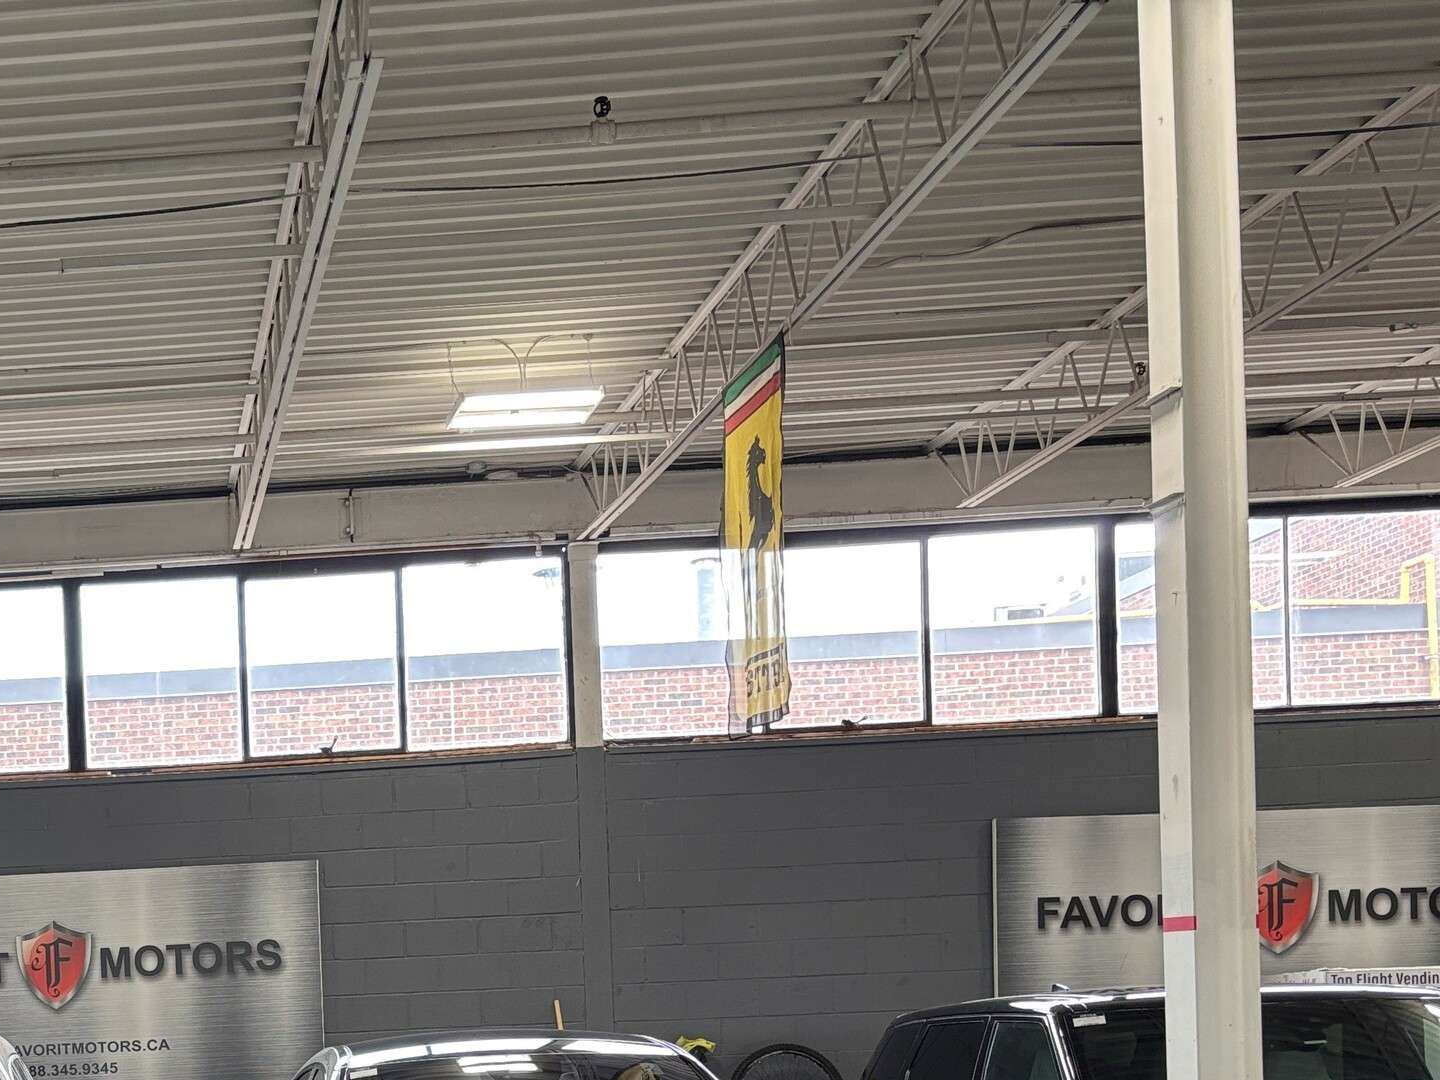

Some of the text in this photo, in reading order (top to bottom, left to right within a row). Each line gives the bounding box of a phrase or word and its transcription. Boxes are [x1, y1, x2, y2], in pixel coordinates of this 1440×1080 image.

[100, 939, 282, 979] MOTORS
[1396, 971, 1440, 985] Vendin
[14, 1039, 170, 1057] AVORITMOTORS.CA
[29, 1062, 118, 1078] 88.345.9345
